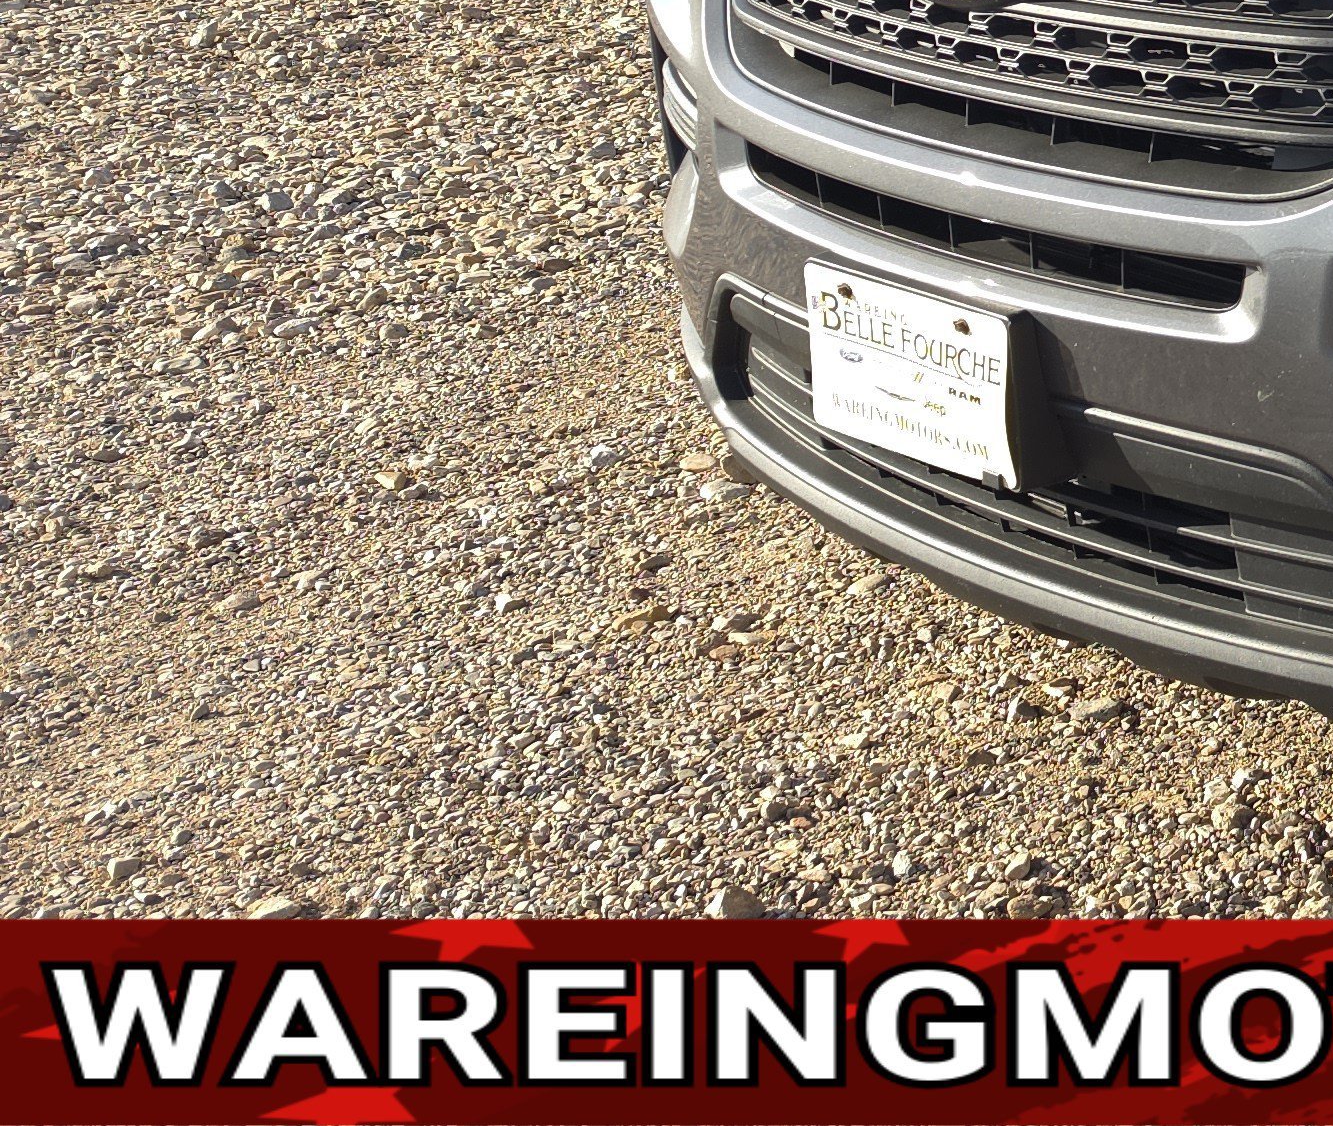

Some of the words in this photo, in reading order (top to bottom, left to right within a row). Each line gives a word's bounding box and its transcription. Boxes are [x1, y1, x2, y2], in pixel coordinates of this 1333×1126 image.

[821, 291, 895, 348] BELLE
[901, 328, 1001, 387] FOURCHE
[948, 386, 982, 406] RAM
